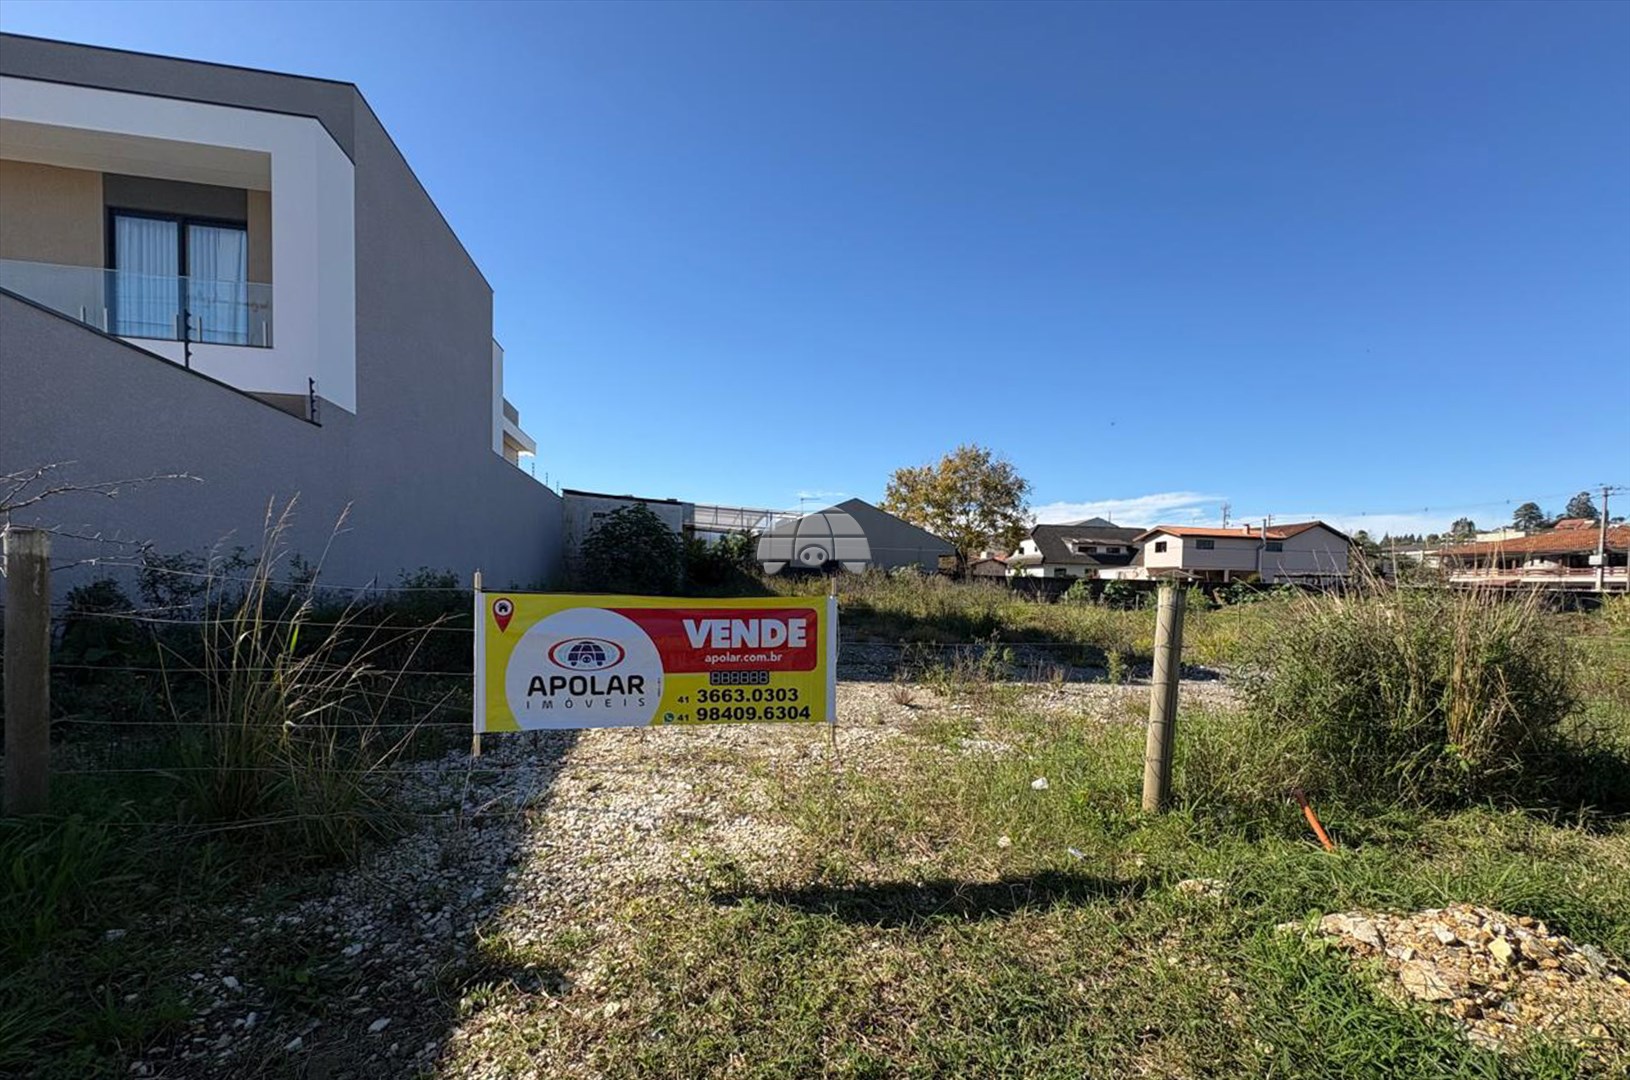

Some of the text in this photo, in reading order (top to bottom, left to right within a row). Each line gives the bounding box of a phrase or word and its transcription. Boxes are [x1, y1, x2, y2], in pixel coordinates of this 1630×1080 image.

[682, 618, 807, 648] VENDE
[704, 651, 783, 664] apolar.com.br
[527, 675, 645, 697] APOLAR
[526, 697, 645, 709] IMÓVEIS
[677, 688, 799, 704] 41 3663.0303
[677, 705, 811, 722] 41 98409.6304
